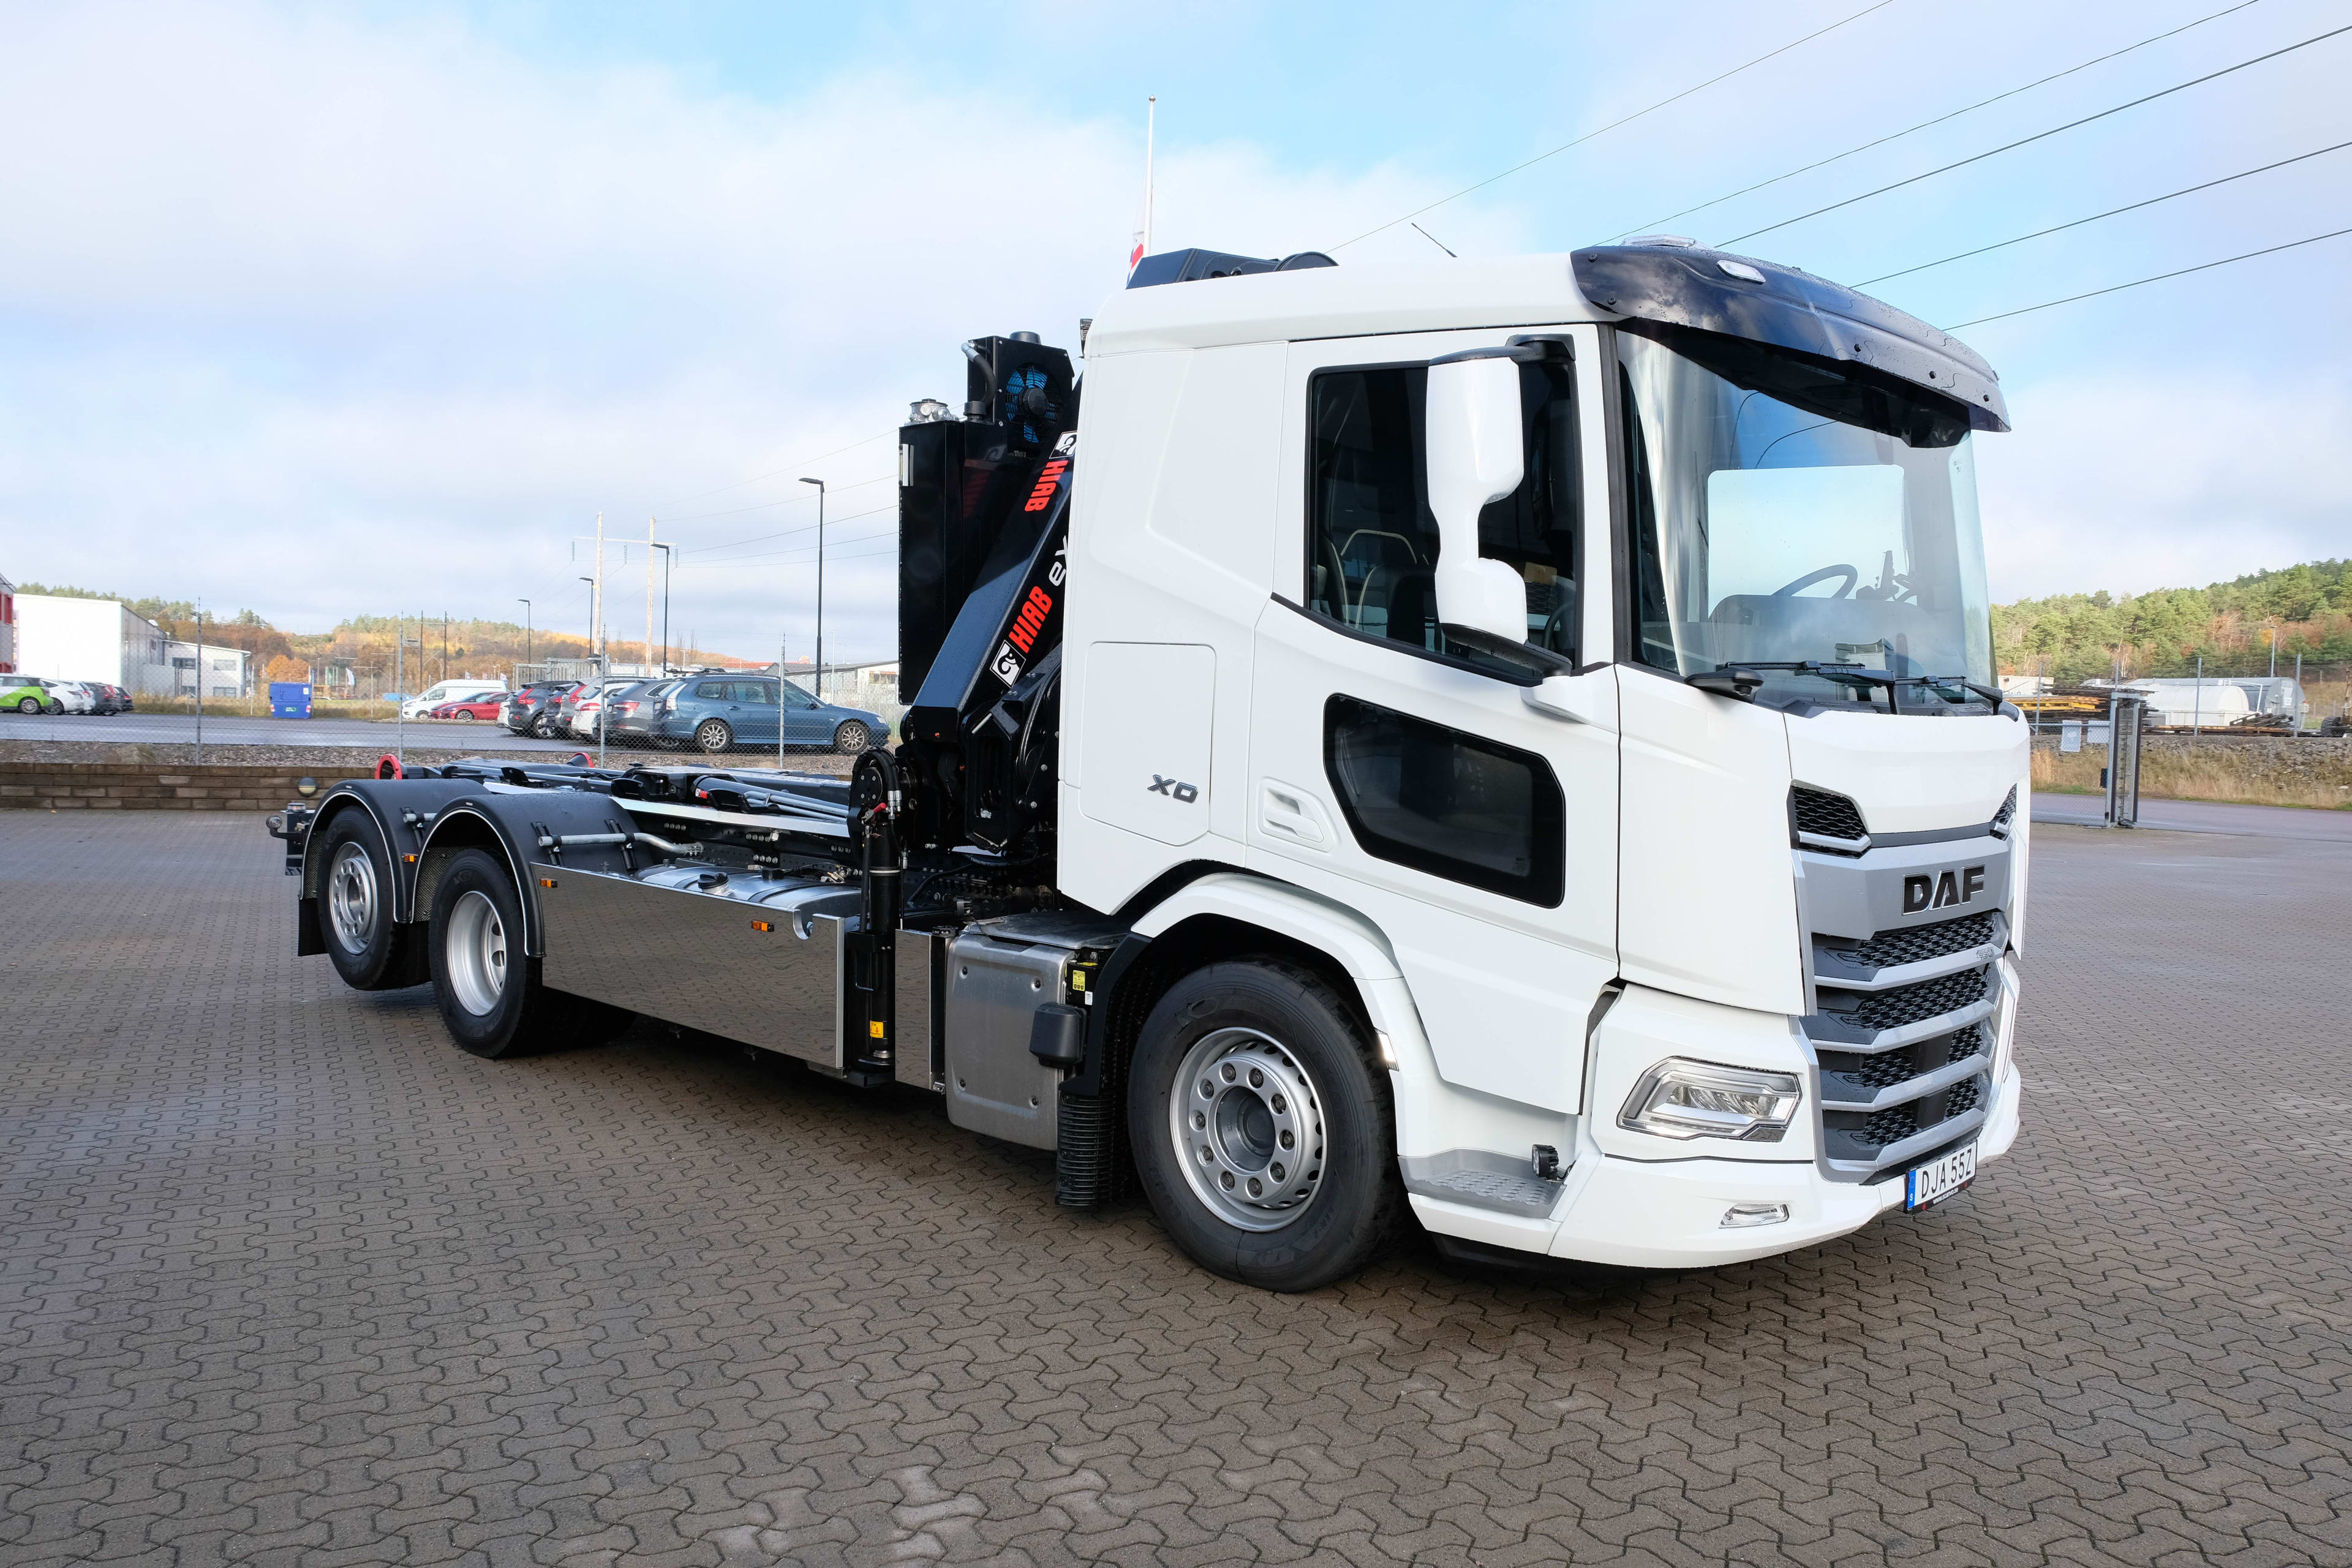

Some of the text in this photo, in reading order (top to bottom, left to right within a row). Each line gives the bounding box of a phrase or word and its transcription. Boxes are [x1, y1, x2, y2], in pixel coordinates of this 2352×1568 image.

[1025, 461, 1069, 512] HIAB
[1009, 586, 1052, 654] HIAB
[1147, 774, 1198, 804] XD
[1902, 863, 1985, 916] DAF
[1921, 1148, 1972, 1199] DJA 55Z
